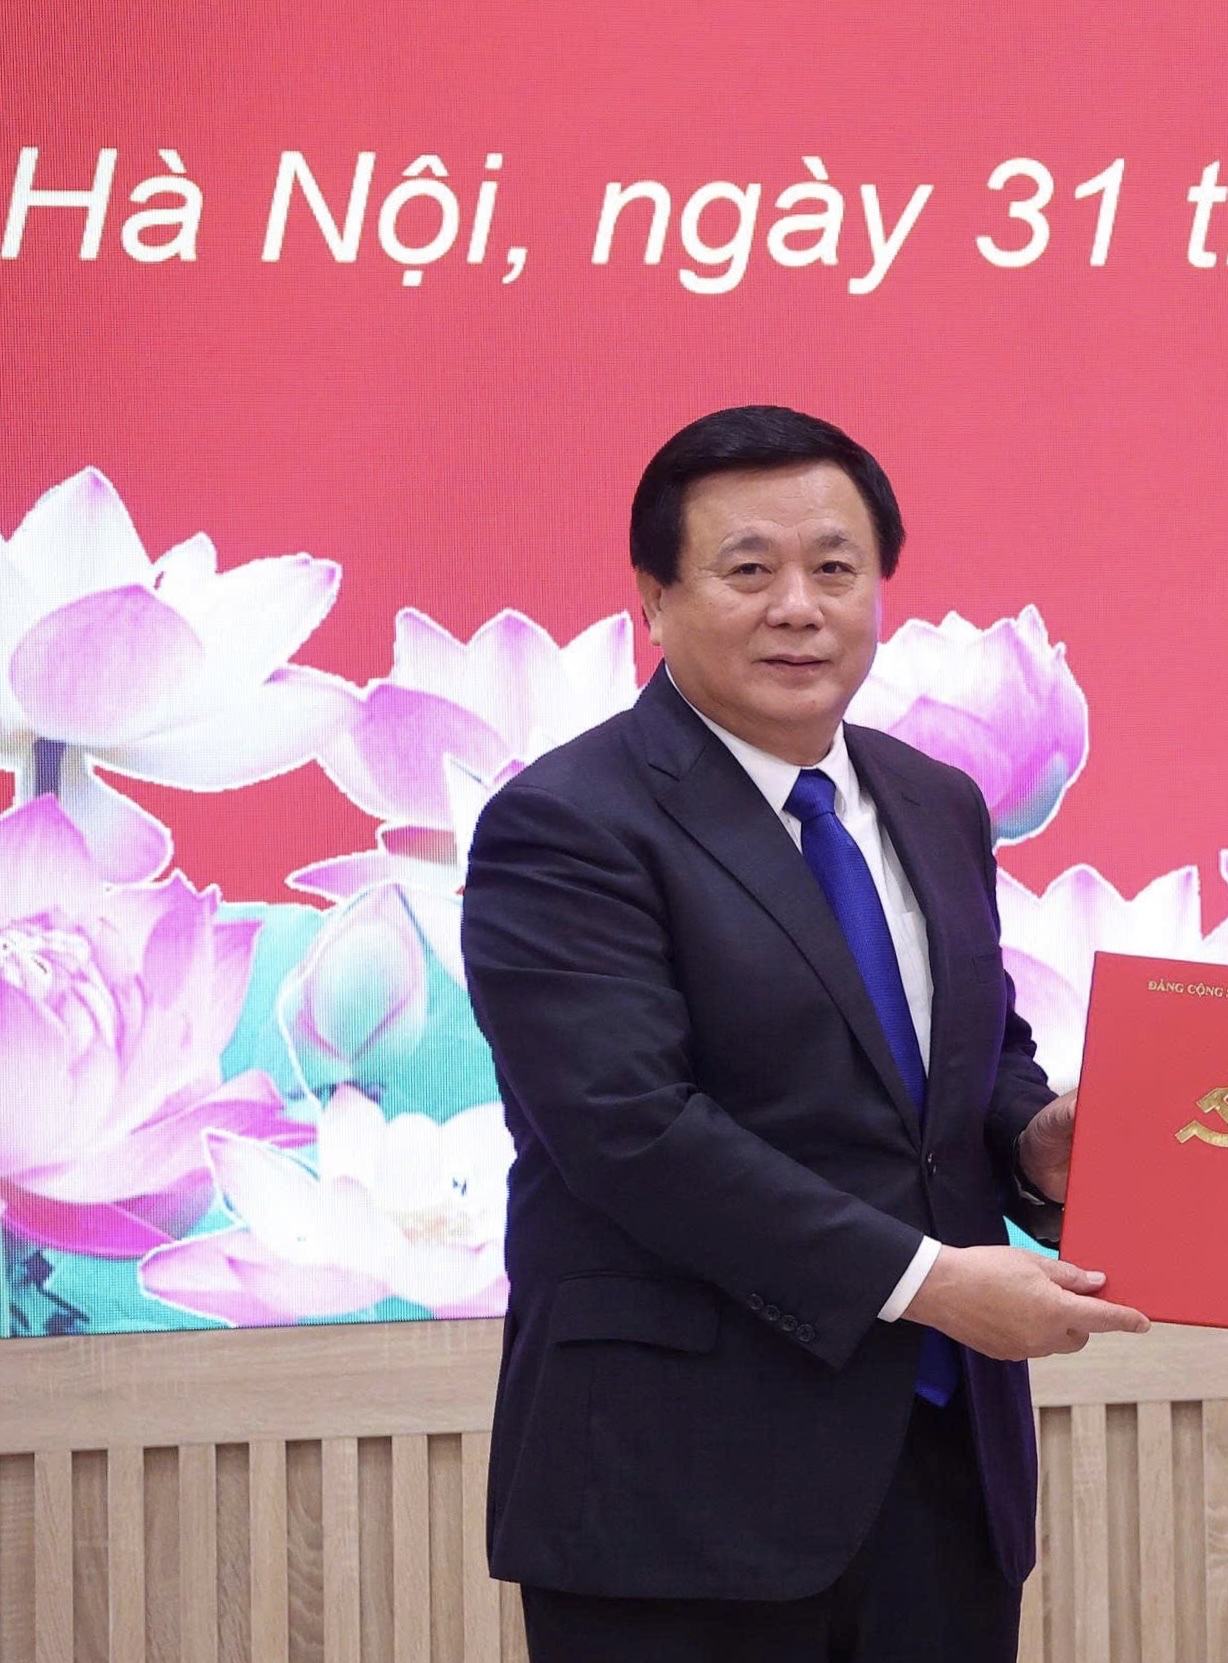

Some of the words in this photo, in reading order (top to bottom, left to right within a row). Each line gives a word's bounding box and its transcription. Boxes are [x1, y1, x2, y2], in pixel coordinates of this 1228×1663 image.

[0, 146, 204, 263] Hà
[260, 150, 528, 287] Nội,
[590, 155, 934, 294] ngày
[975, 157, 1124, 268] 31
[1148, 979, 1184, 993] ĐẢNG
[1188, 983, 1223, 997] CỘNG
